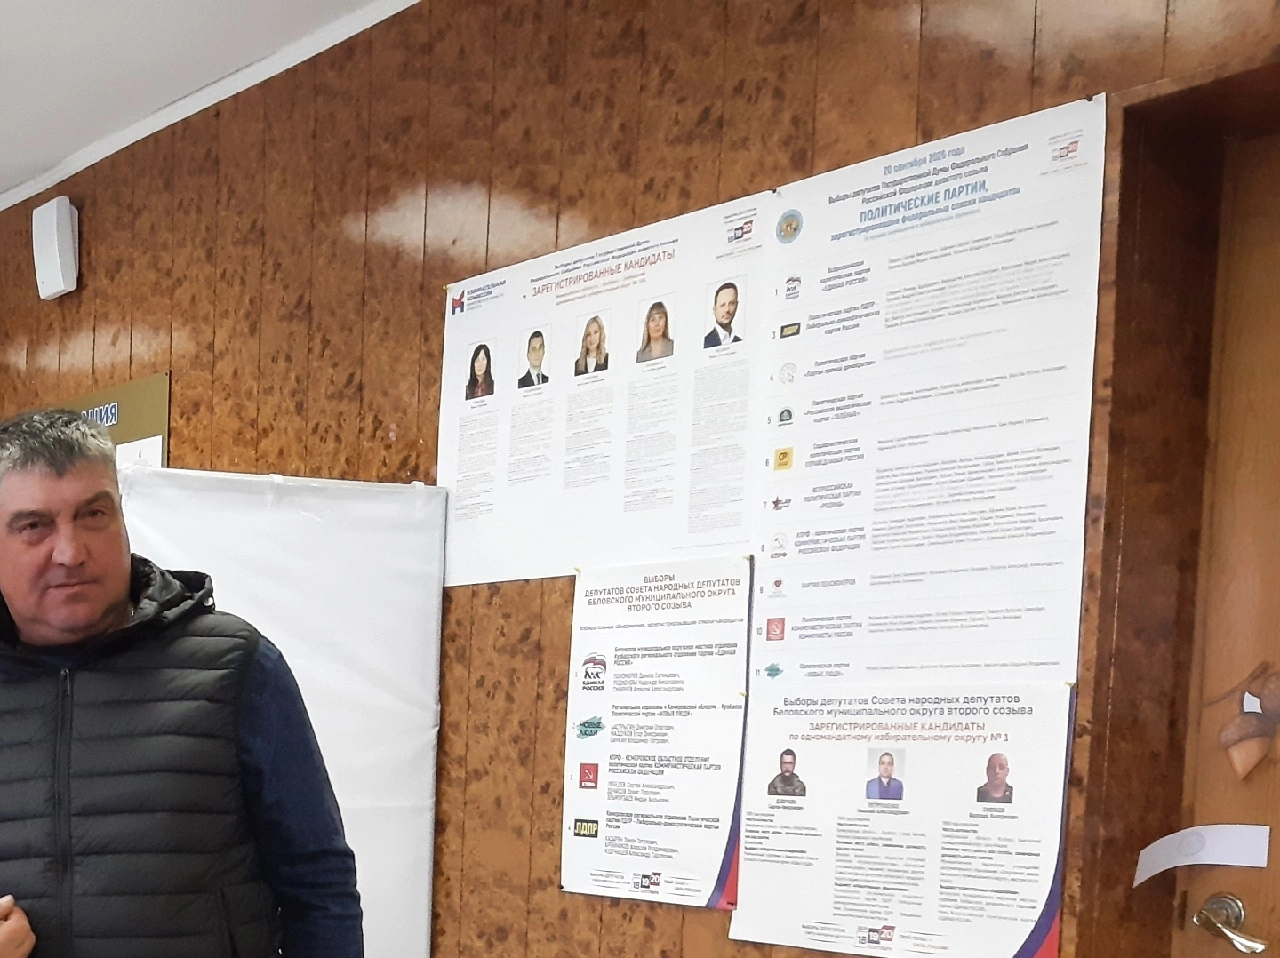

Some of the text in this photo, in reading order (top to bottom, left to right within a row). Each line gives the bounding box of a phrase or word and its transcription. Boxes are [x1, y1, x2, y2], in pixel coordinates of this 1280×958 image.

[859, 179, 989, 223] ПОЛИТИЧЕСКИЕ ПАРТИИ,
[531, 262, 622, 297] ЗАРЕГИСТРИРОВАННЫЕ
[624, 250, 676, 271] КАНДИДАТЫ
[643, 574, 675, 584] ВЫБОРЫ
[585, 578, 740, 598] ДЕПУТАТОВ СОВЕТА НАРОДНЫХ ДЕПУТАТОВ
[588, 588, 736, 606] БЕЛОВСКОГО МУНИЦИПАЛЬНОГО ОКРУГА
[627, 601, 692, 612] ВТОРОГО СОЗЫВА
[783, 695, 1020, 708] Выборы депутатов Совета народных депутатов
[773, 706, 1033, 718] Беловского муниципального округа второго созыва
[809, 722, 985, 732] ЗАРЕГИСТРИРОВАННЫЕ КАНДИДАТЫ
[574, 822, 597, 835] ЛДПР
[642, 877, 649, 886] 19
[650, 874, 660, 883] 20
